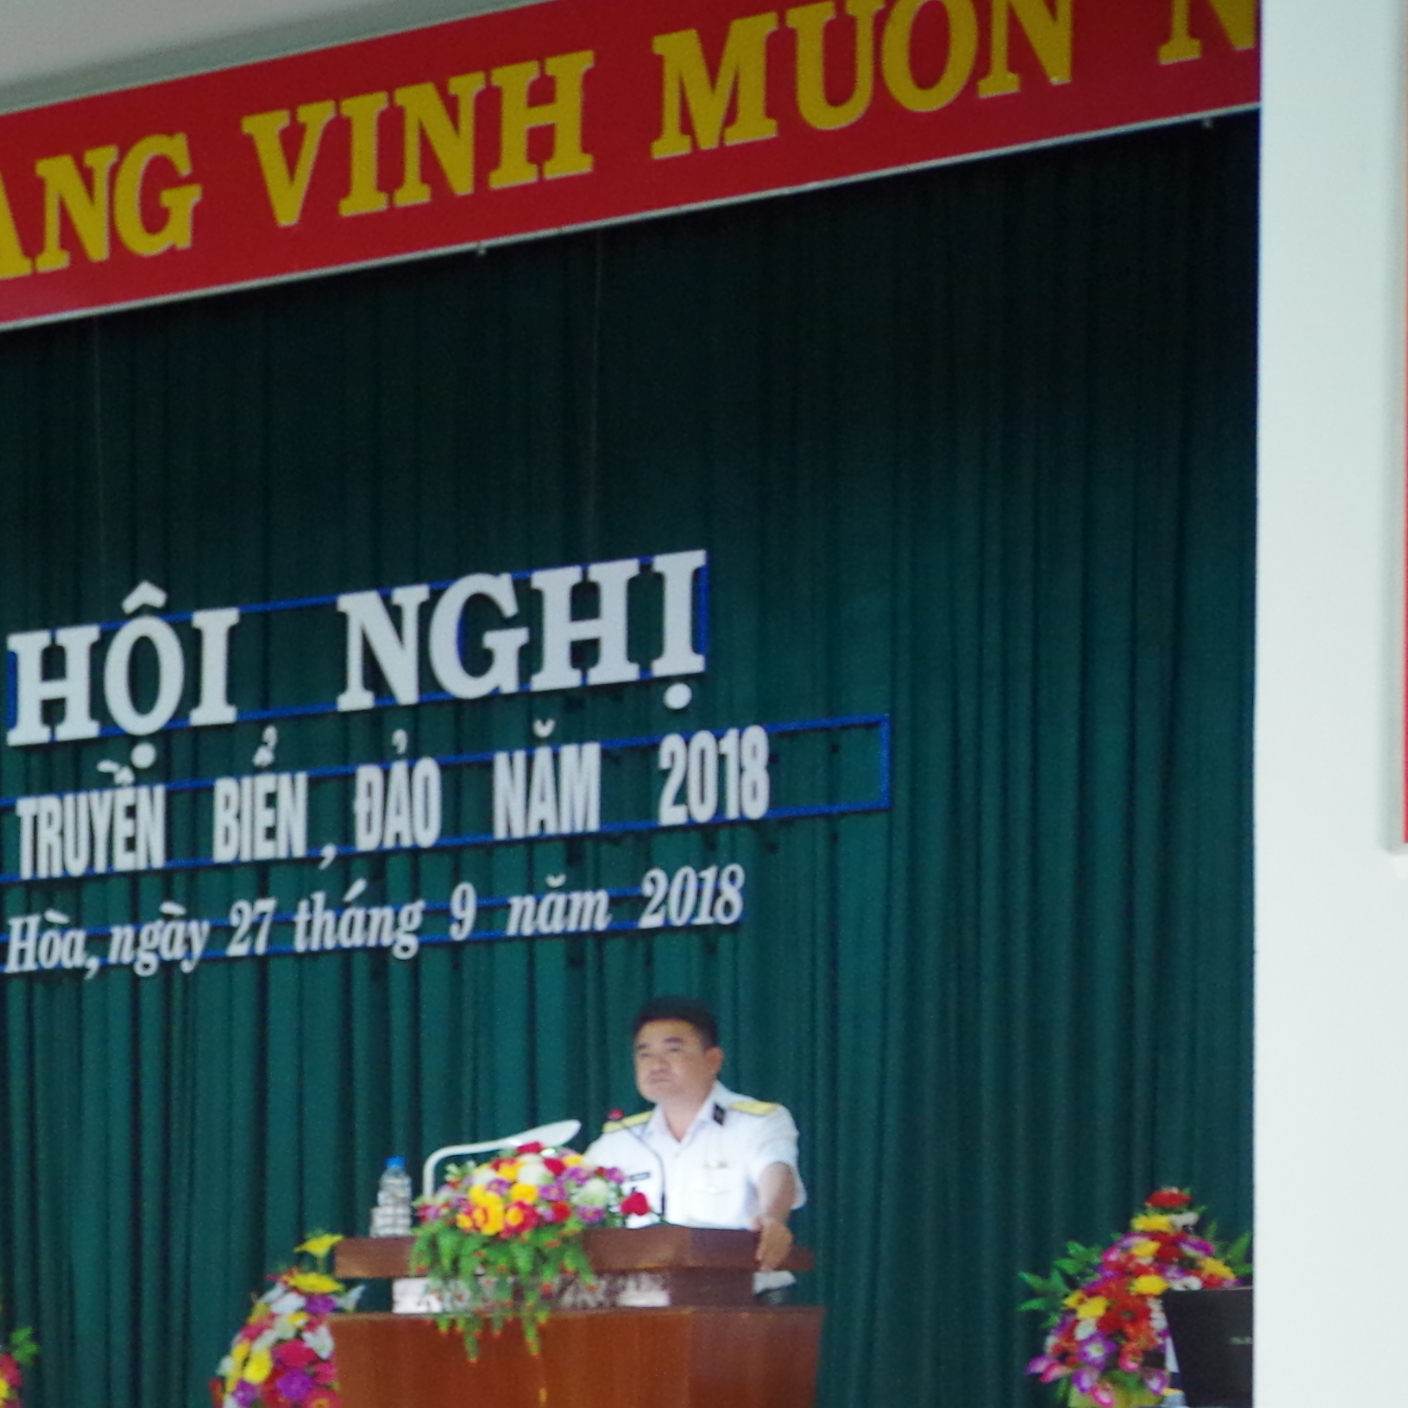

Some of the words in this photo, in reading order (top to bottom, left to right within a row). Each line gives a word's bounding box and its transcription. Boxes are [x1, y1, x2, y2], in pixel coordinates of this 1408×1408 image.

[241, 48, 595, 228] VINH
[7, 581, 239, 770] HỘI
[337, 549, 706, 711] NGHỊ
[16, 759, 166, 880] TRUYỀN
[354, 729, 442, 852] ĐẢO
[493, 718, 601, 840] NĂM
[658, 724, 771, 827] 2018
[108, 901, 211, 977] ngày
[225, 897, 278, 957] 27
[293, 878, 425, 960] tháng
[449, 881, 478, 941] 9
[505, 872, 612, 937] năm
[637, 863, 746, 929] 2018
